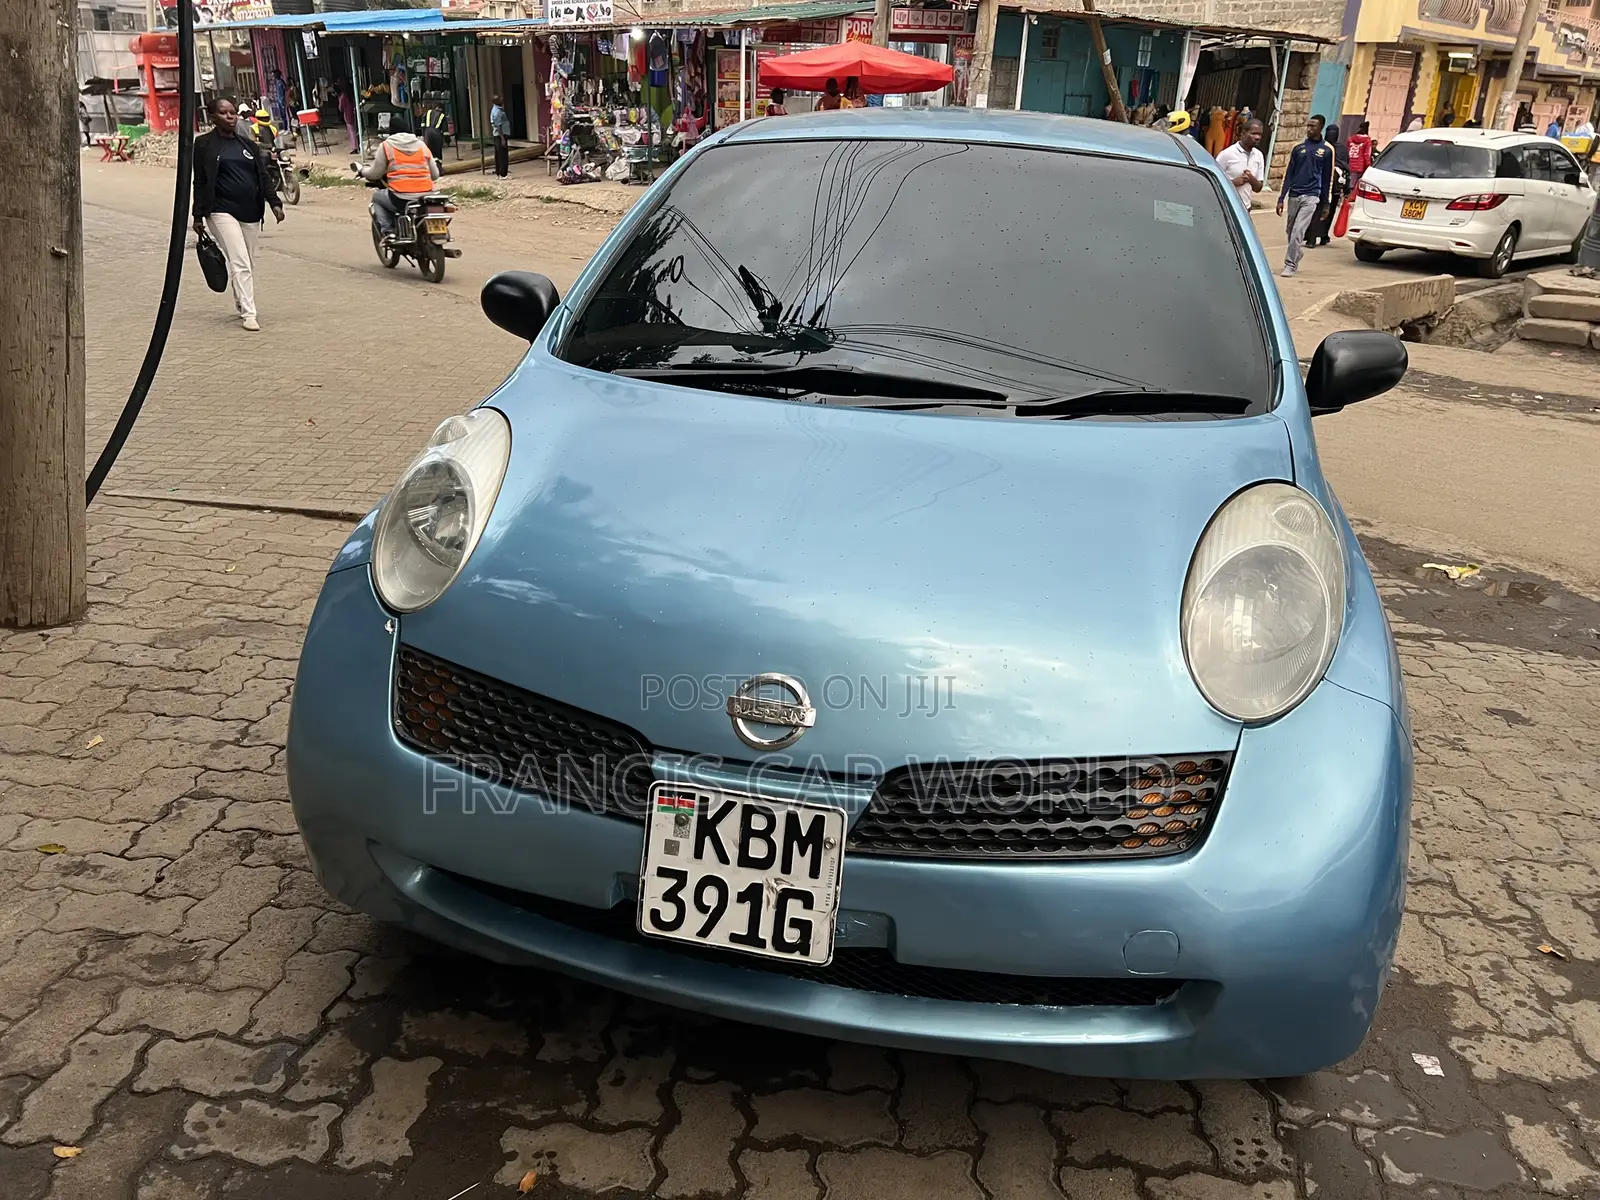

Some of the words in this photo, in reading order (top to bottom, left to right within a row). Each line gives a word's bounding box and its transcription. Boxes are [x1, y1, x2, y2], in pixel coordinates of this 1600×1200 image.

[955, 37, 973, 48] POR
[1408, 199, 1426, 209] KCV
[733, 702, 807, 724] NISSAN
[693, 795, 826, 880] KBM
[650, 866, 815, 957] 391G
